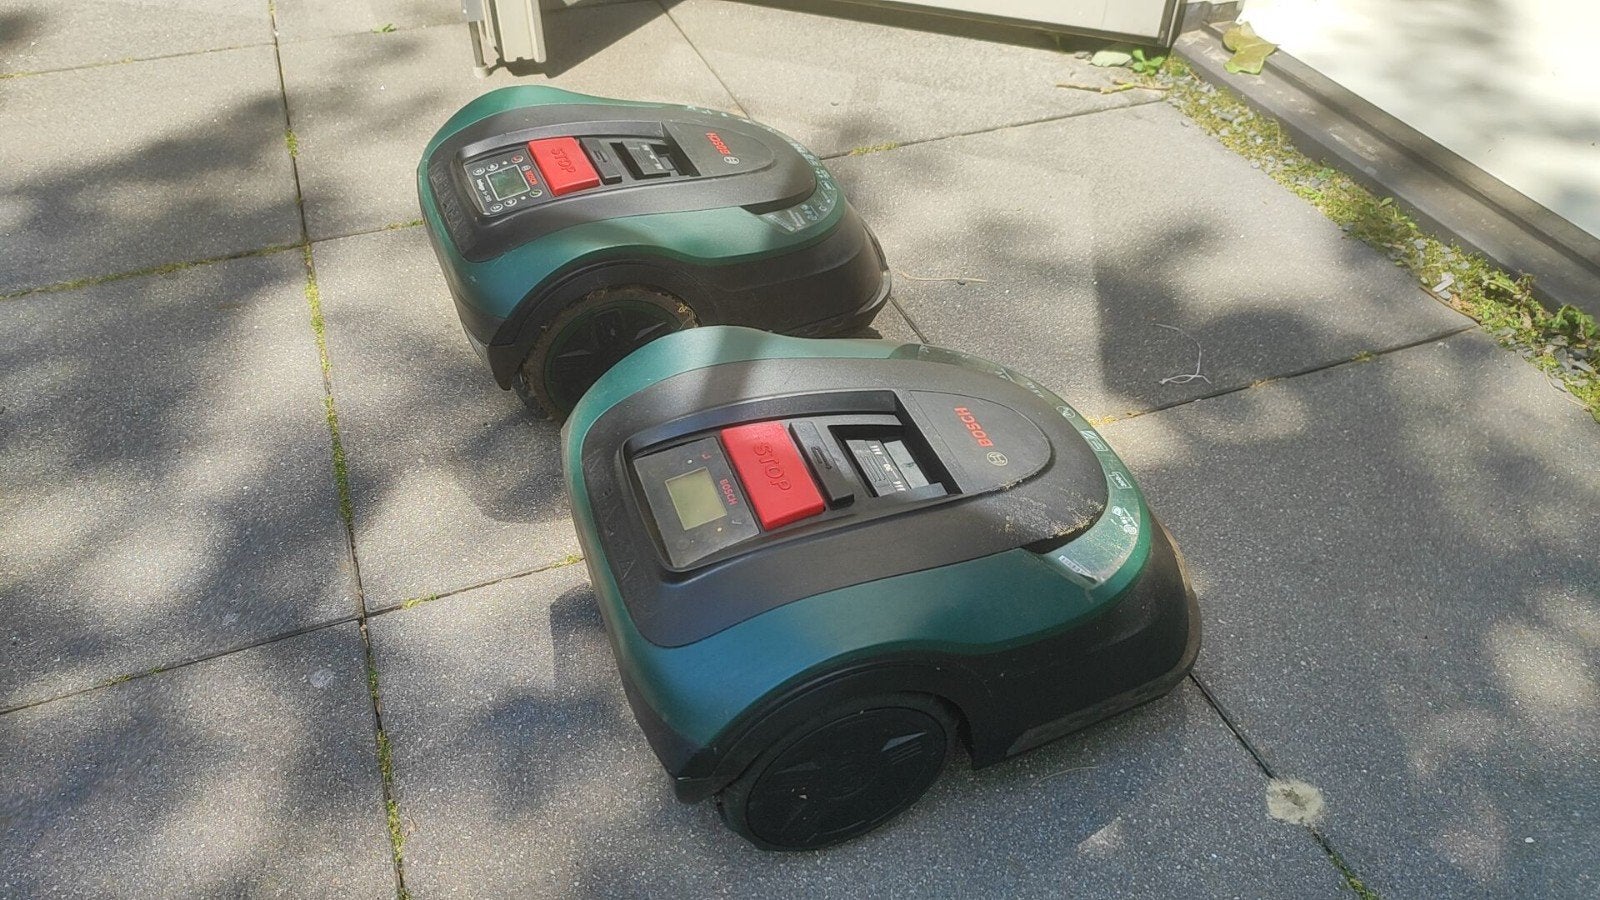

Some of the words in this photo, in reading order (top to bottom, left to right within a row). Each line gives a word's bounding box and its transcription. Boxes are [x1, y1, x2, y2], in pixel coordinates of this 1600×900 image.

[705, 131, 731, 156] BOSCH
[551, 148, 576, 173] STOP
[954, 406, 994, 448] BOSCH
[753, 442, 791, 491] STOP
[719, 478, 739, 506] BOSCH
